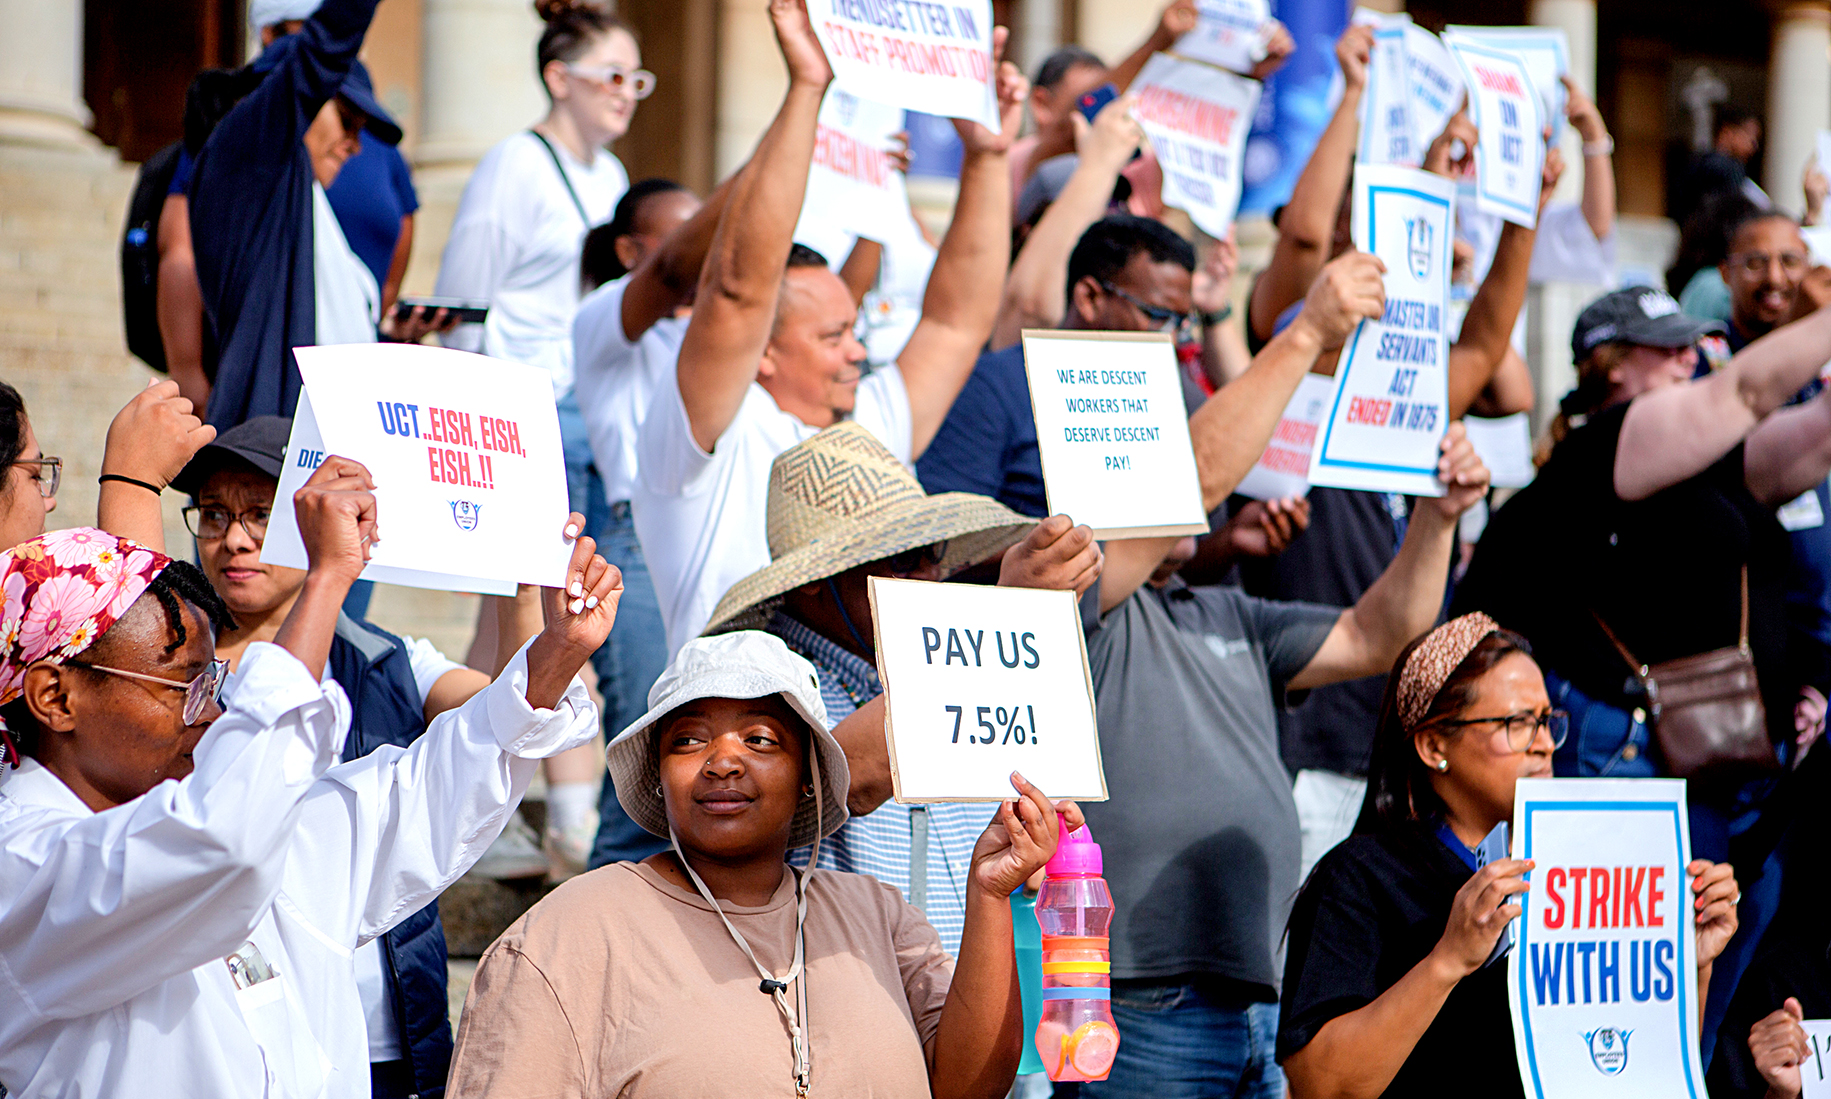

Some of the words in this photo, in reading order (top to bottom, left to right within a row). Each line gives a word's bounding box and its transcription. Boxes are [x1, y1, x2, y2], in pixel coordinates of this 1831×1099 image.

[953, 6, 981, 41] IN
[824, 21, 880, 67] STAFF
[1379, 298, 1425, 330] MASTER
[1376, 332, 1438, 367] SERVANTS
[1056, 369, 1075, 384] WE
[1078, 370, 1099, 385] ARE
[1101, 370, 1147, 385] DESCENT
[1388, 367, 1418, 397] ACT
[1065, 398, 1120, 413] WORKERS
[1121, 399, 1149, 413] THAT
[1346, 396, 1393, 427] ENDED
[1388, 401, 1409, 428] IN
[1406, 403, 1439, 433] 1875
[479, 415, 526, 458] EISH,
[1064, 427, 1112, 442] DESERVE
[1114, 427, 1160, 442] DESCENT
[428, 446, 494, 489] EISH..!!
[1105, 455, 1131, 470] PAY!
[922, 627, 984, 667] PAY
[995, 631, 1040, 669] US
[945, 705, 1038, 745] 7.5%!
[1543, 867, 1665, 930] STRIKE
[1530, 941, 1620, 1006] WITH
[1630, 939, 1675, 1002] US
